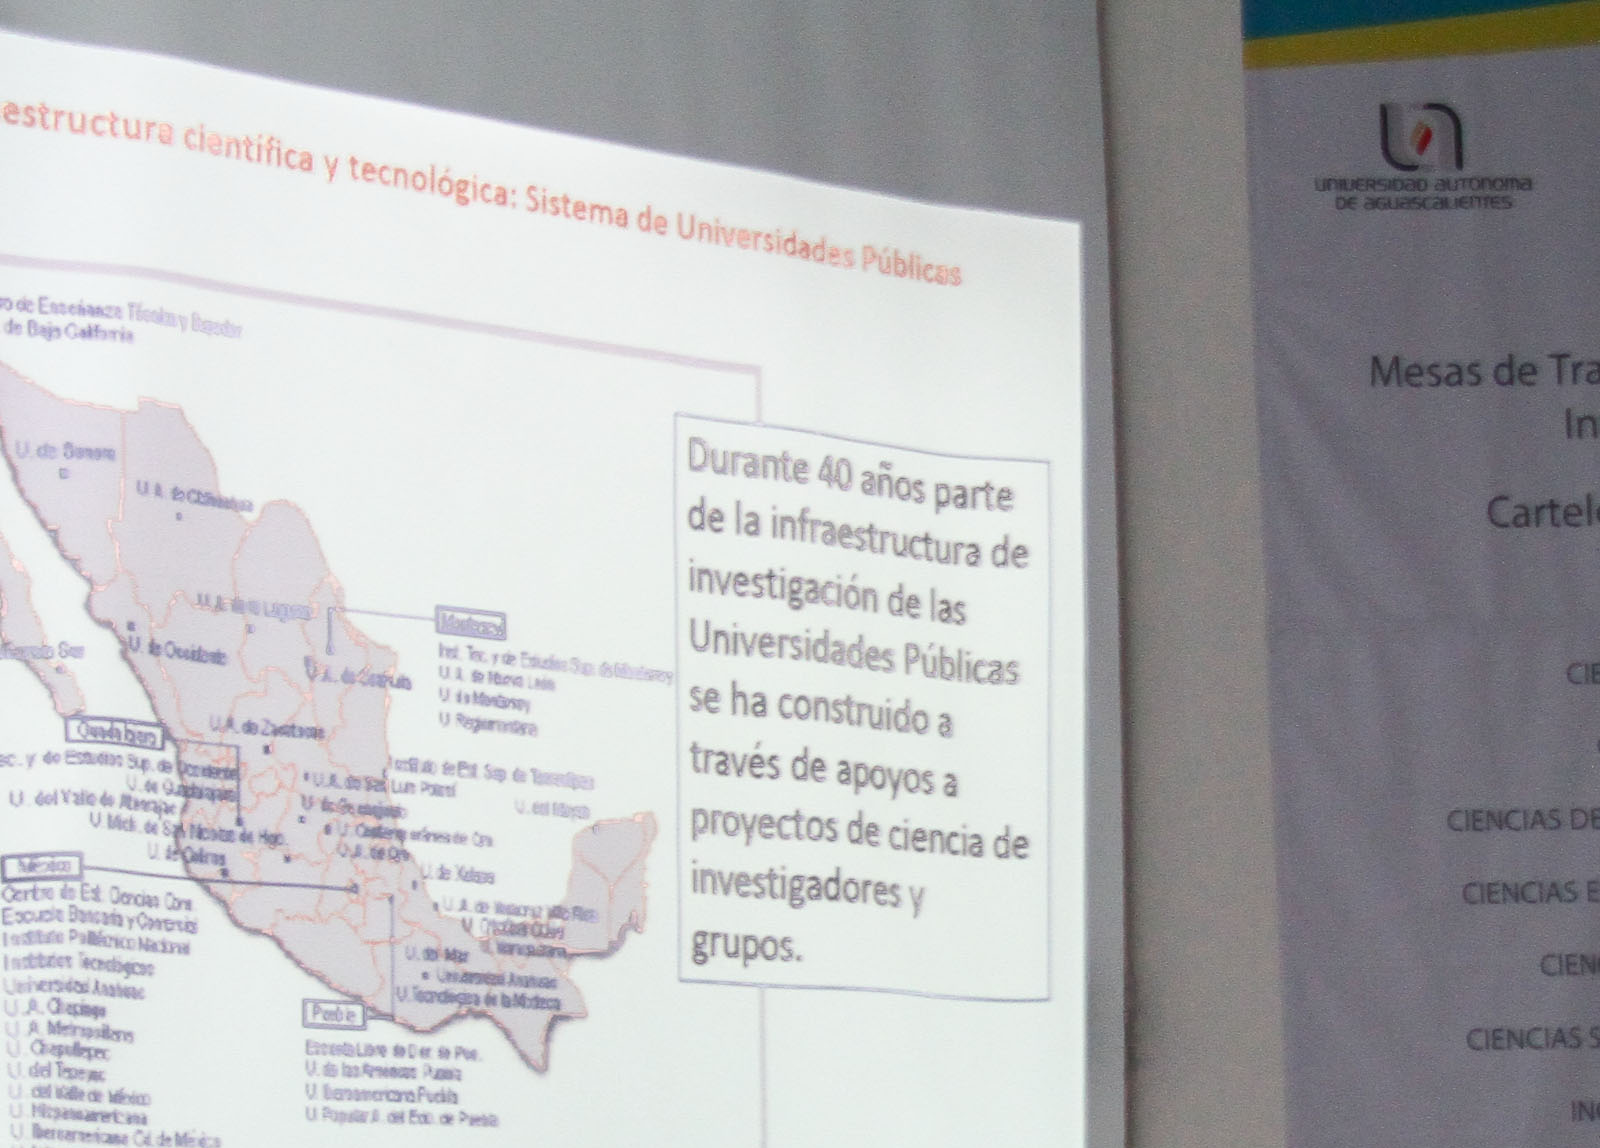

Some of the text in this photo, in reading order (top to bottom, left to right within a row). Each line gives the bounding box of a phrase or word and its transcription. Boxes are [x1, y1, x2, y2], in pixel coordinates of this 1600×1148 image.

[183, 124, 314, 174] científica
[324, 151, 339, 183] y
[350, 153, 517, 210] tecnológica:
[526, 184, 629, 230] Sistema
[637, 204, 668, 236] de
[677, 213, 855, 270] Universidades
[862, 243, 963, 287] Públicas
[1370, 355, 1482, 388] Mesas
[1493, 354, 1538, 387] de
[688, 436, 1015, 514] Durante 40 años parte
[688, 496, 1030, 569] de la infraestructura de
[1488, 493, 1600, 529] Cartel
[688, 558, 968, 626] investigación de las
[689, 617, 896, 674] Universidades
[904, 640, 1022, 686] Públicas
[689, 679, 953, 739] se ha construido a
[689, 740, 959, 800] través de apoyos a
[691, 806, 1031, 860] proyectos de ciencia de
[1447, 808, 1561, 832] CIENCIAS
[691, 858, 925, 920] investigadores y
[1462, 880, 1578, 905] CIENCIAS
[691, 928, 804, 969] grupos.
[1540, 953, 1600, 977] CIEN
[1466, 1026, 1582, 1051] CIENCIAS
